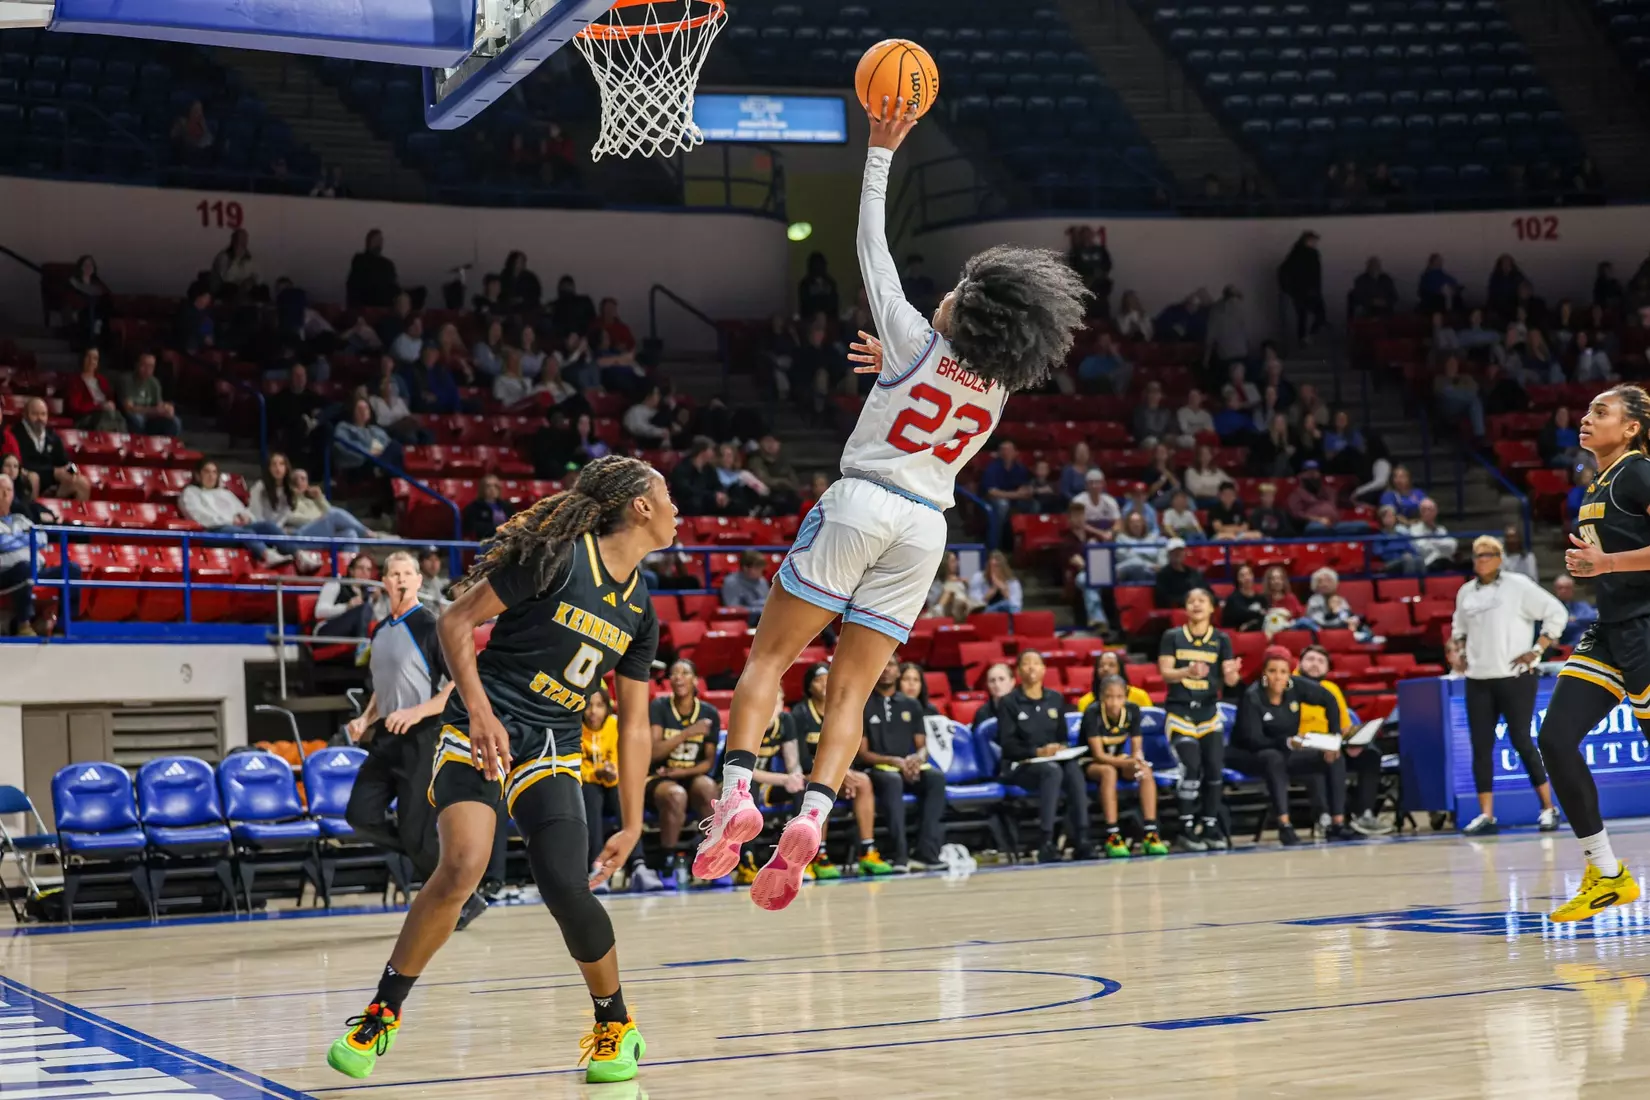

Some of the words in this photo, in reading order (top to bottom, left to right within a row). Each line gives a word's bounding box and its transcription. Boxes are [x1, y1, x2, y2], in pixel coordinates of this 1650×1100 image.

[905, 72, 921, 112] lson
[196, 199, 243, 229] 119
[1511, 216, 1560, 241] 102
[936, 356, 997, 394] BRADLEY
[886, 382, 993, 464] 23
[563, 641, 604, 689] 0
